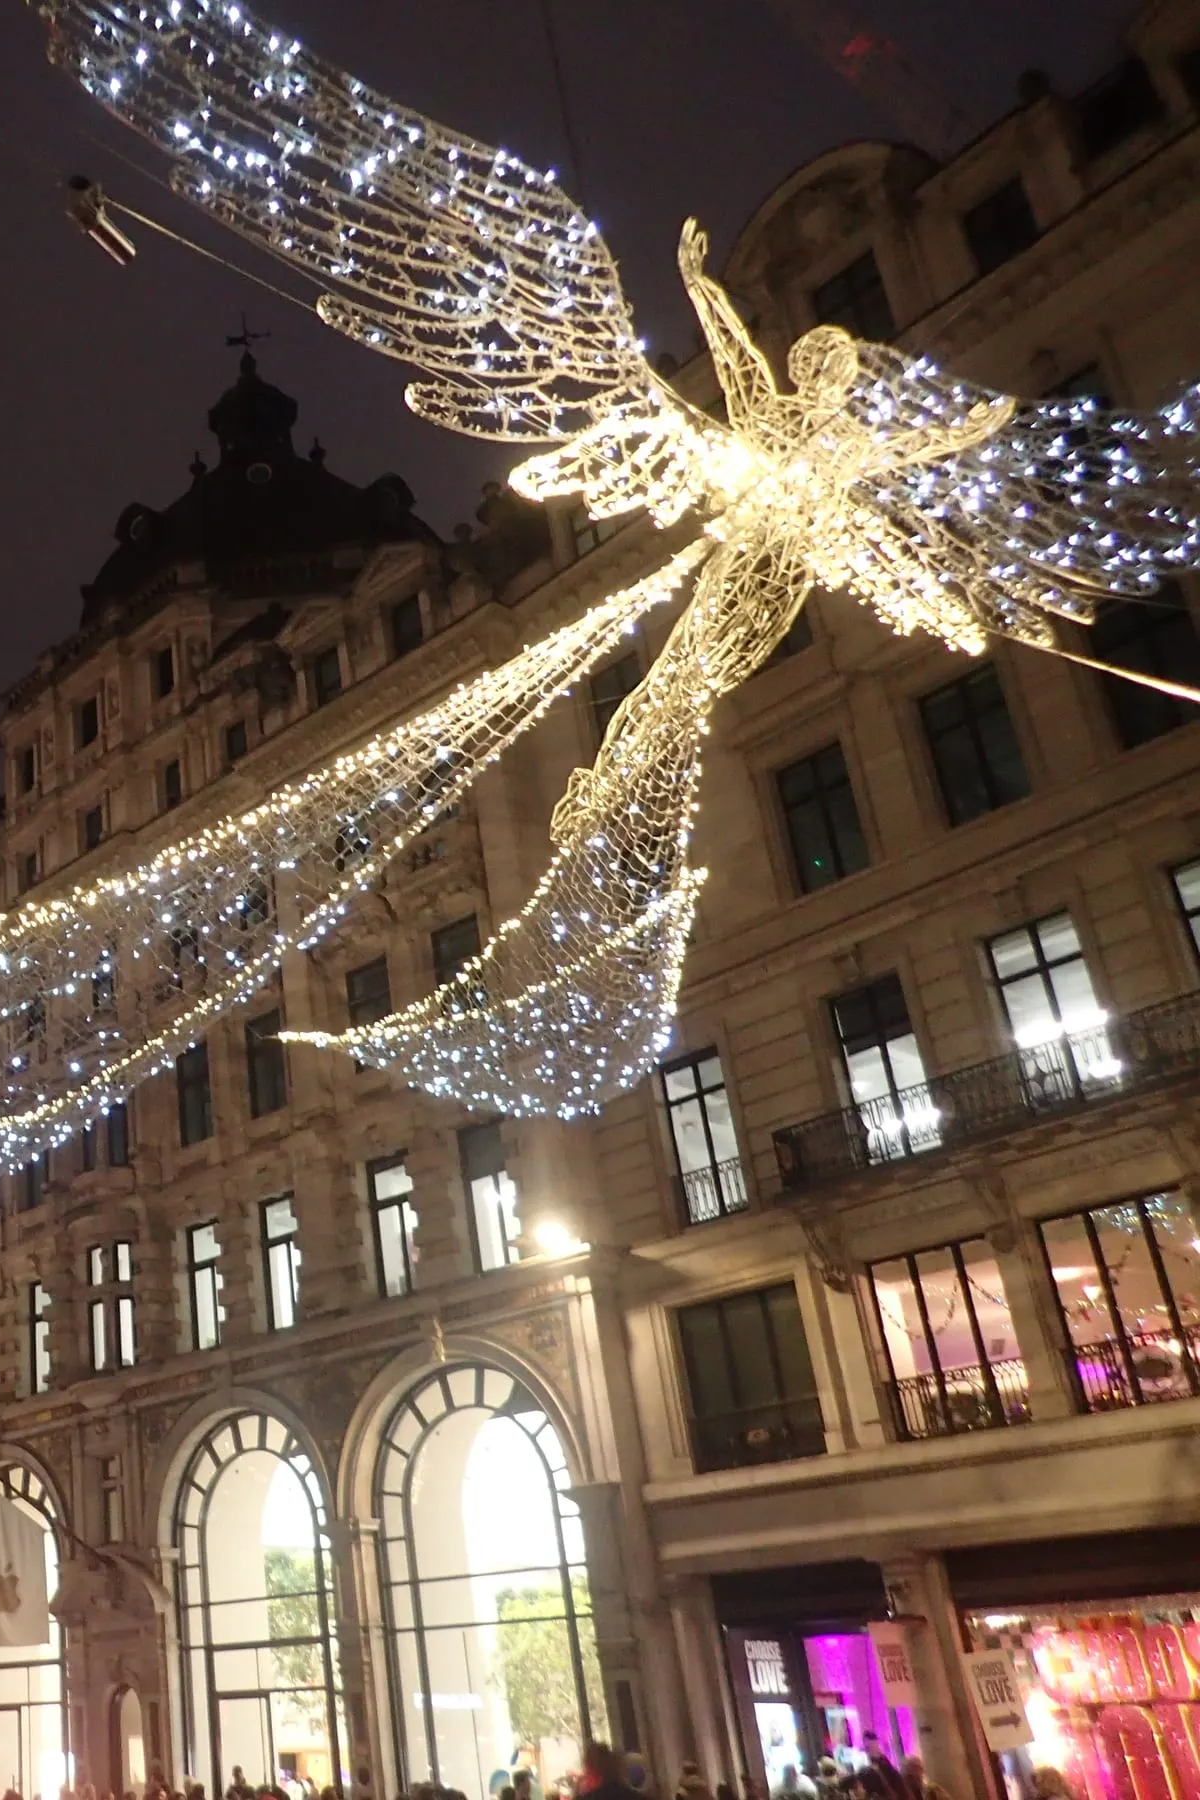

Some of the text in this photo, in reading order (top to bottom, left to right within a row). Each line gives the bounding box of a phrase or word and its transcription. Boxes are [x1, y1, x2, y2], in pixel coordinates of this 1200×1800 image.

[744, 1639, 783, 1660] CHOOSE
[749, 1659, 790, 1694] LOVE
[880, 1657, 911, 1684] LOVE
[972, 1661, 1004, 1678] CHOOSE
[976, 1676, 1015, 1705] LOVE
